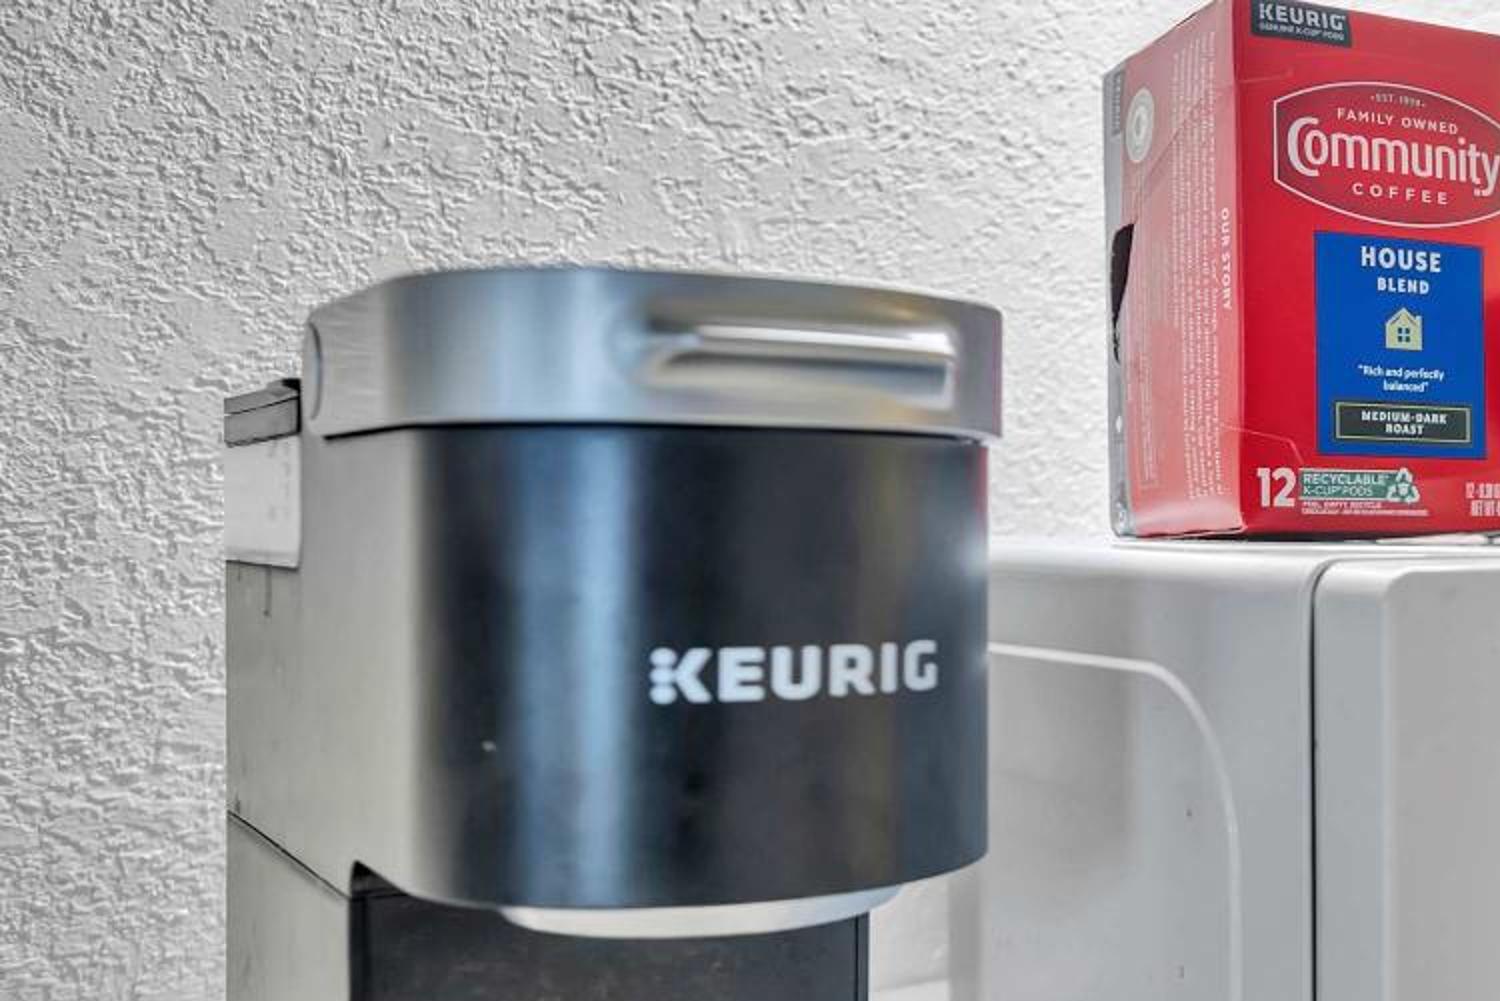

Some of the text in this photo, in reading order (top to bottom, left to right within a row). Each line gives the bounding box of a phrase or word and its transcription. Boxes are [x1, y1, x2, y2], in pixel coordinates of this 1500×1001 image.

[1259, 3, 1345, 31] KEURIG
[1337, 107, 1459, 135] FAMILY OWNED
[1287, 116, 1500, 197] Community
[1352, 182, 1449, 205] COFFEE
[1220, 207, 1232, 310] OUR STORY
[1361, 245, 1442, 273] HOUSE
[1377, 276, 1430, 295] BLEND
[1386, 366, 1402, 377] and
[1361, 410, 1448, 425] MEDIUM-DARK
[1385, 424, 1425, 435] ROAST
[1256, 467, 1298, 508] 12
[1342, 485, 1373, 497] PODS
[650, 639, 939, 704] KEURIG
